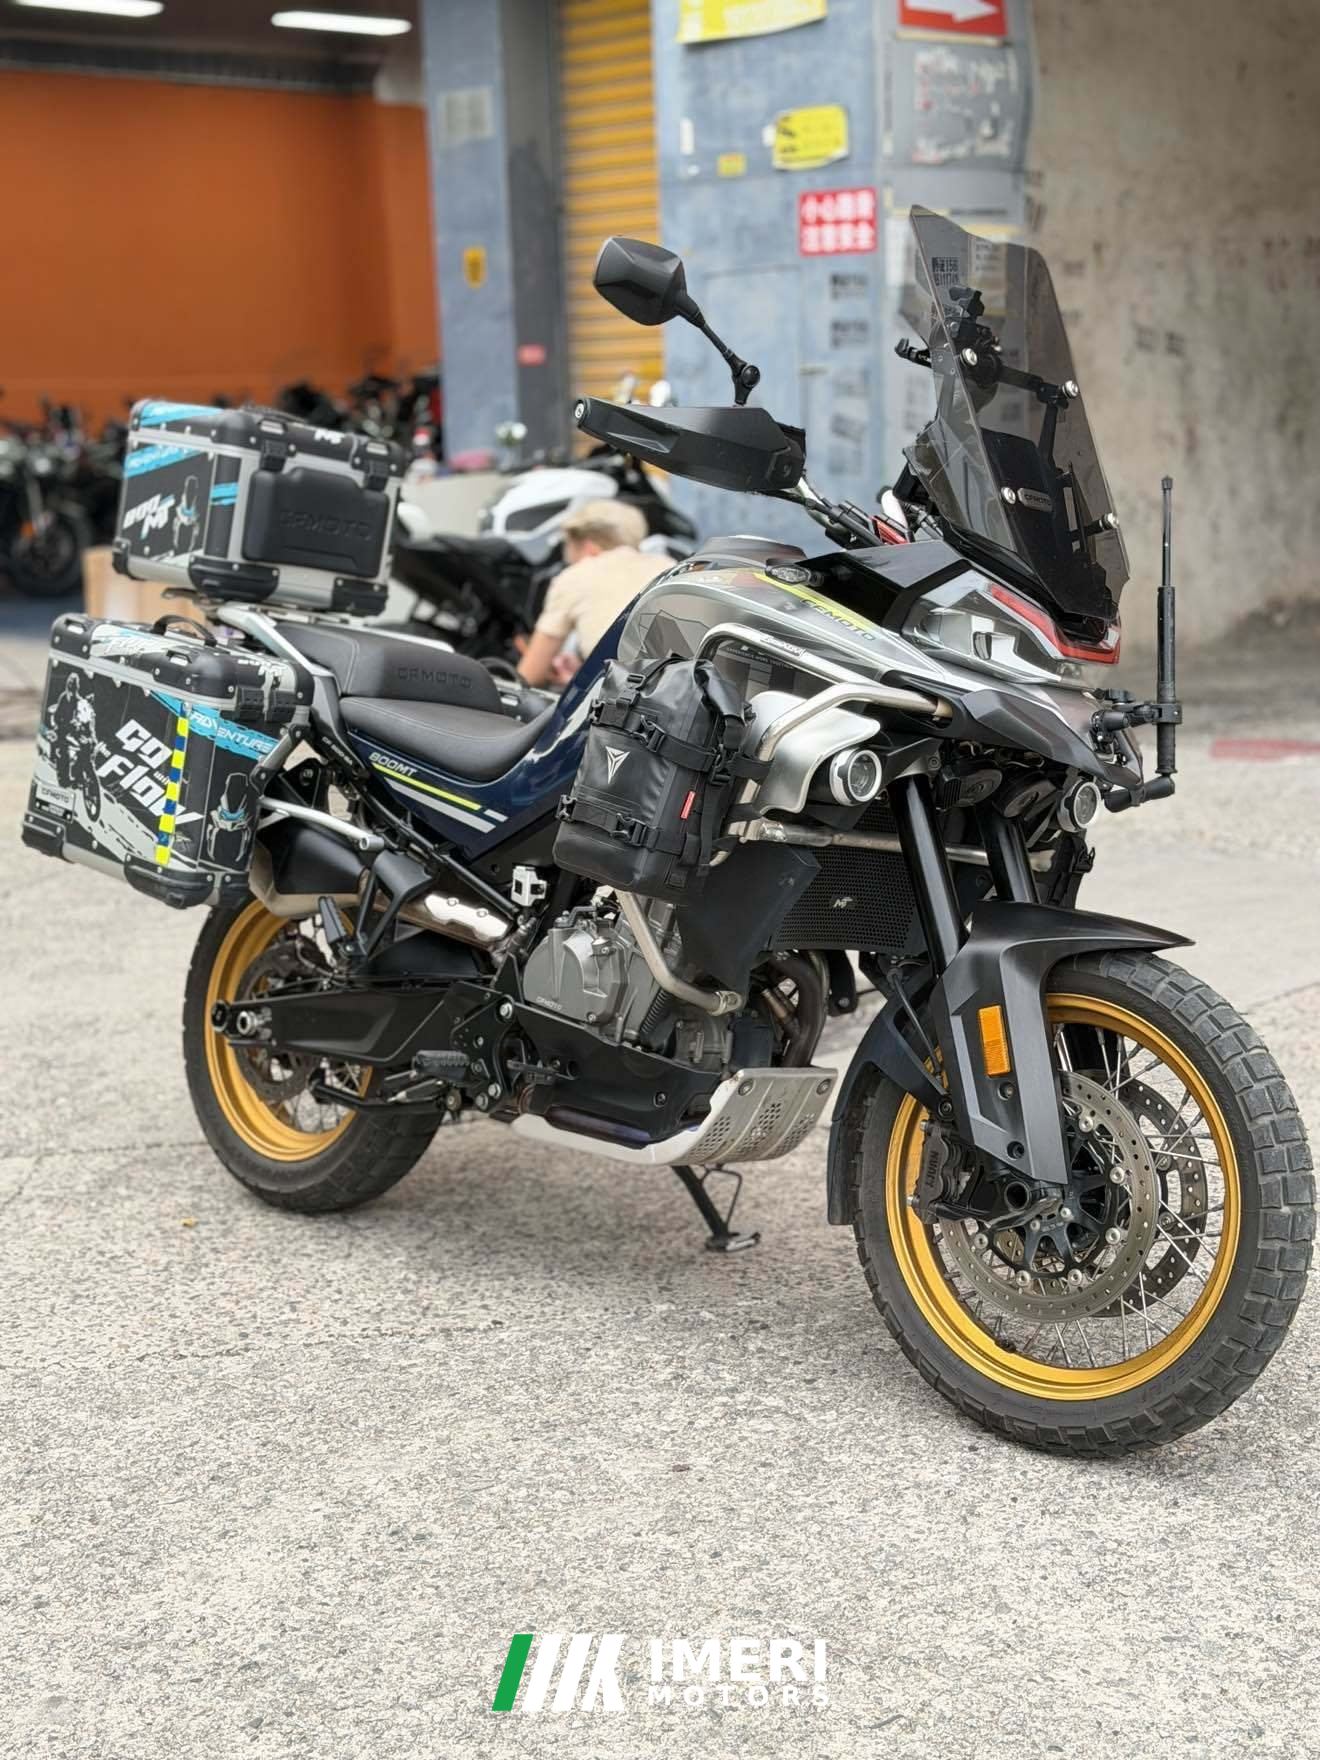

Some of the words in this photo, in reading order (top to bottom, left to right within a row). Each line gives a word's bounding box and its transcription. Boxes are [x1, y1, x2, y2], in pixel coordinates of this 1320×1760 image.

[801, 599, 876, 641] CFMOTO
[398, 667, 472, 689] CFMOTO
[190, 713, 275, 756] ADVENTURE
[368, 751, 418, 777] 800MT
